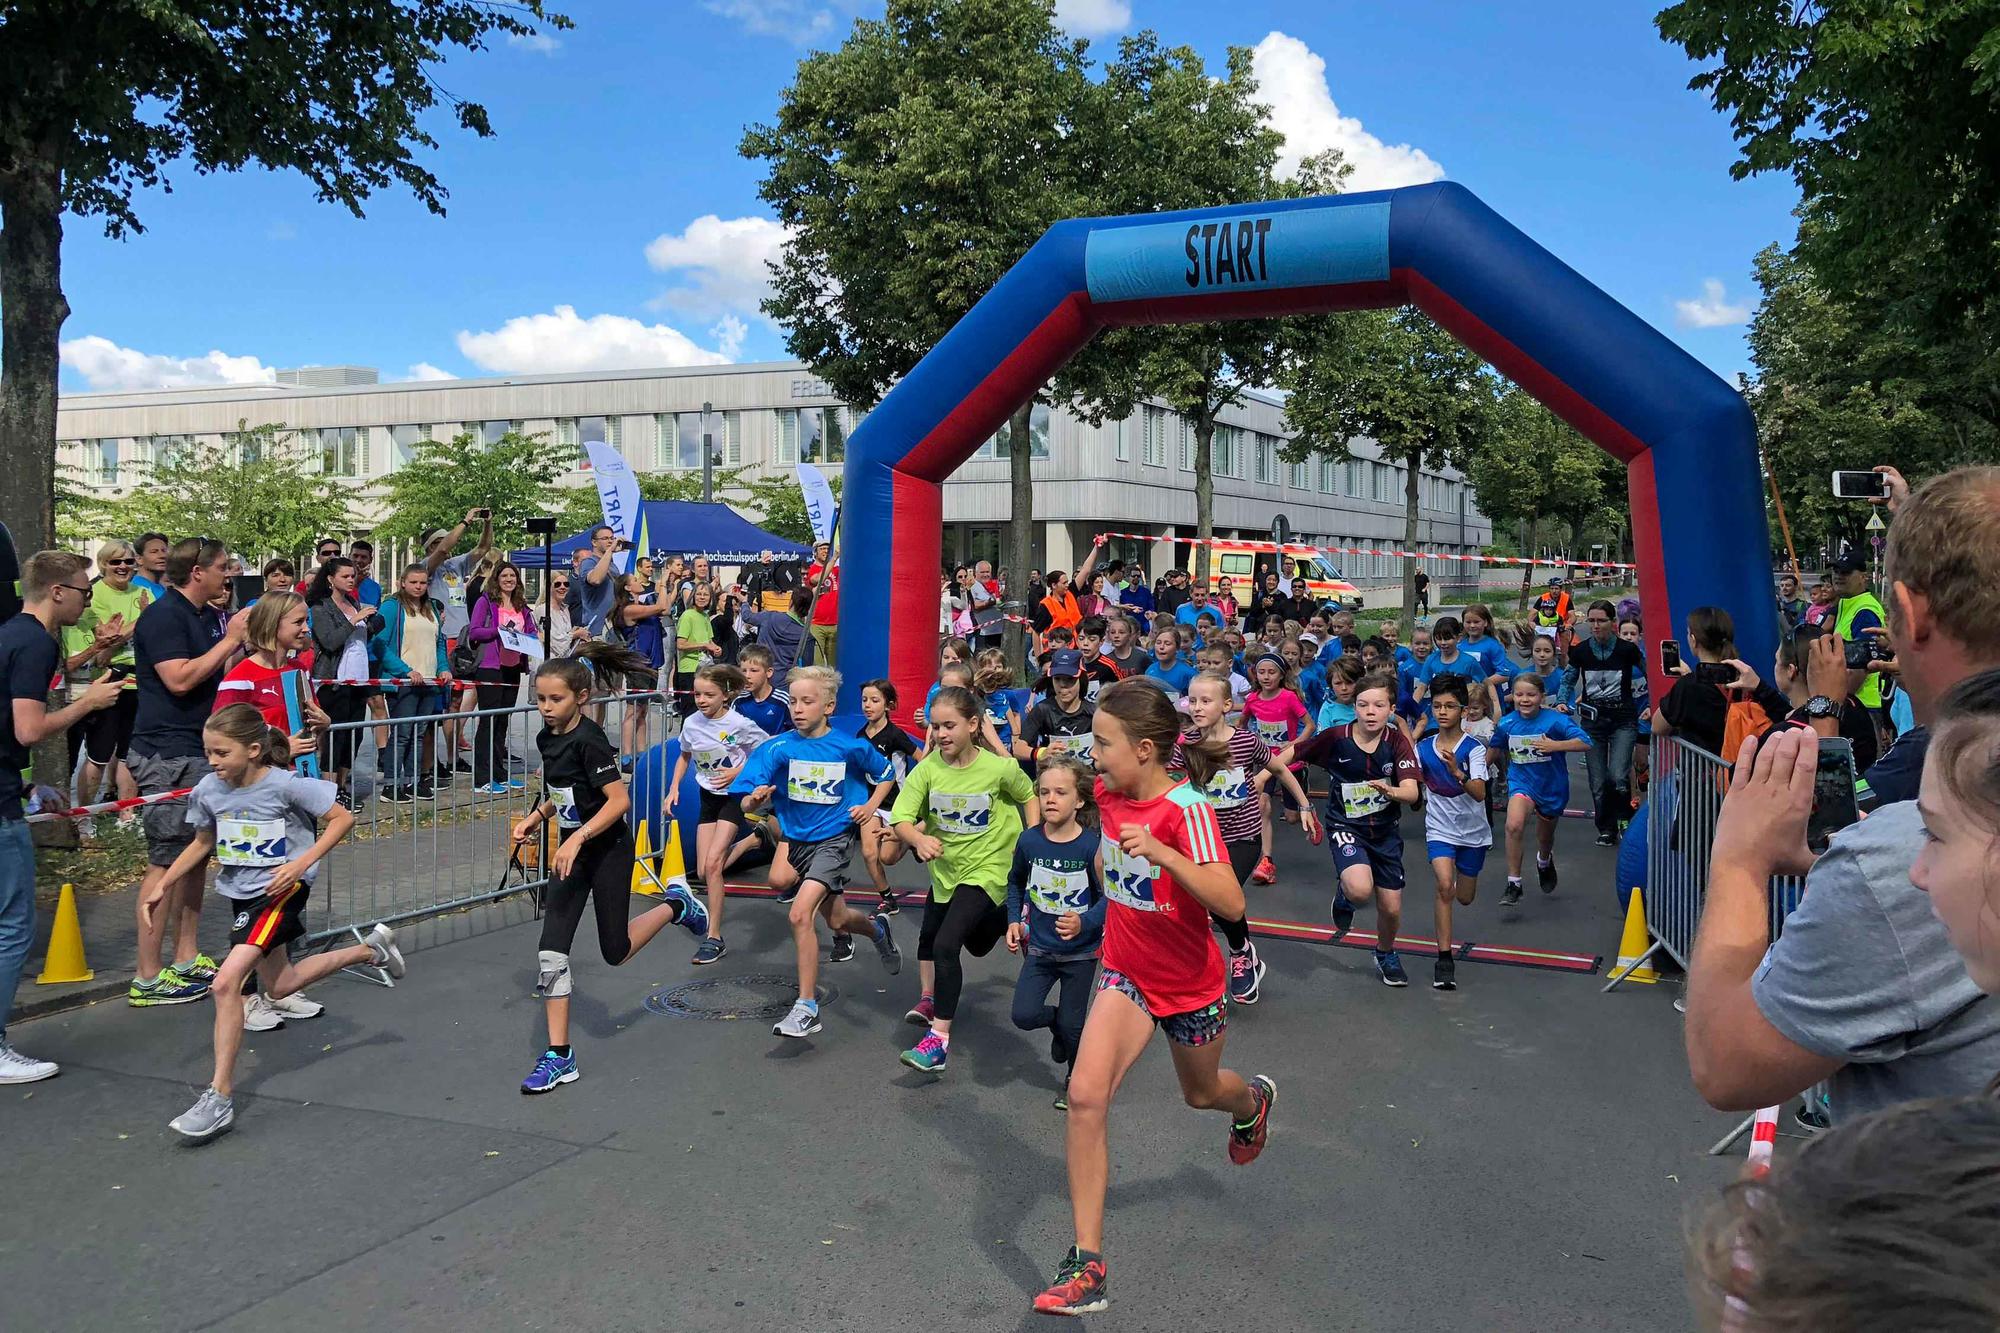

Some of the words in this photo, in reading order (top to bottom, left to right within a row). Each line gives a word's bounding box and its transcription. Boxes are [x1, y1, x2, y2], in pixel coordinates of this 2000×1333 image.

[1185, 218, 1272, 288] START
[809, 766, 825, 777] 24
[1110, 847, 1123, 866] 11
[1064, 860, 1084, 869] DEF
